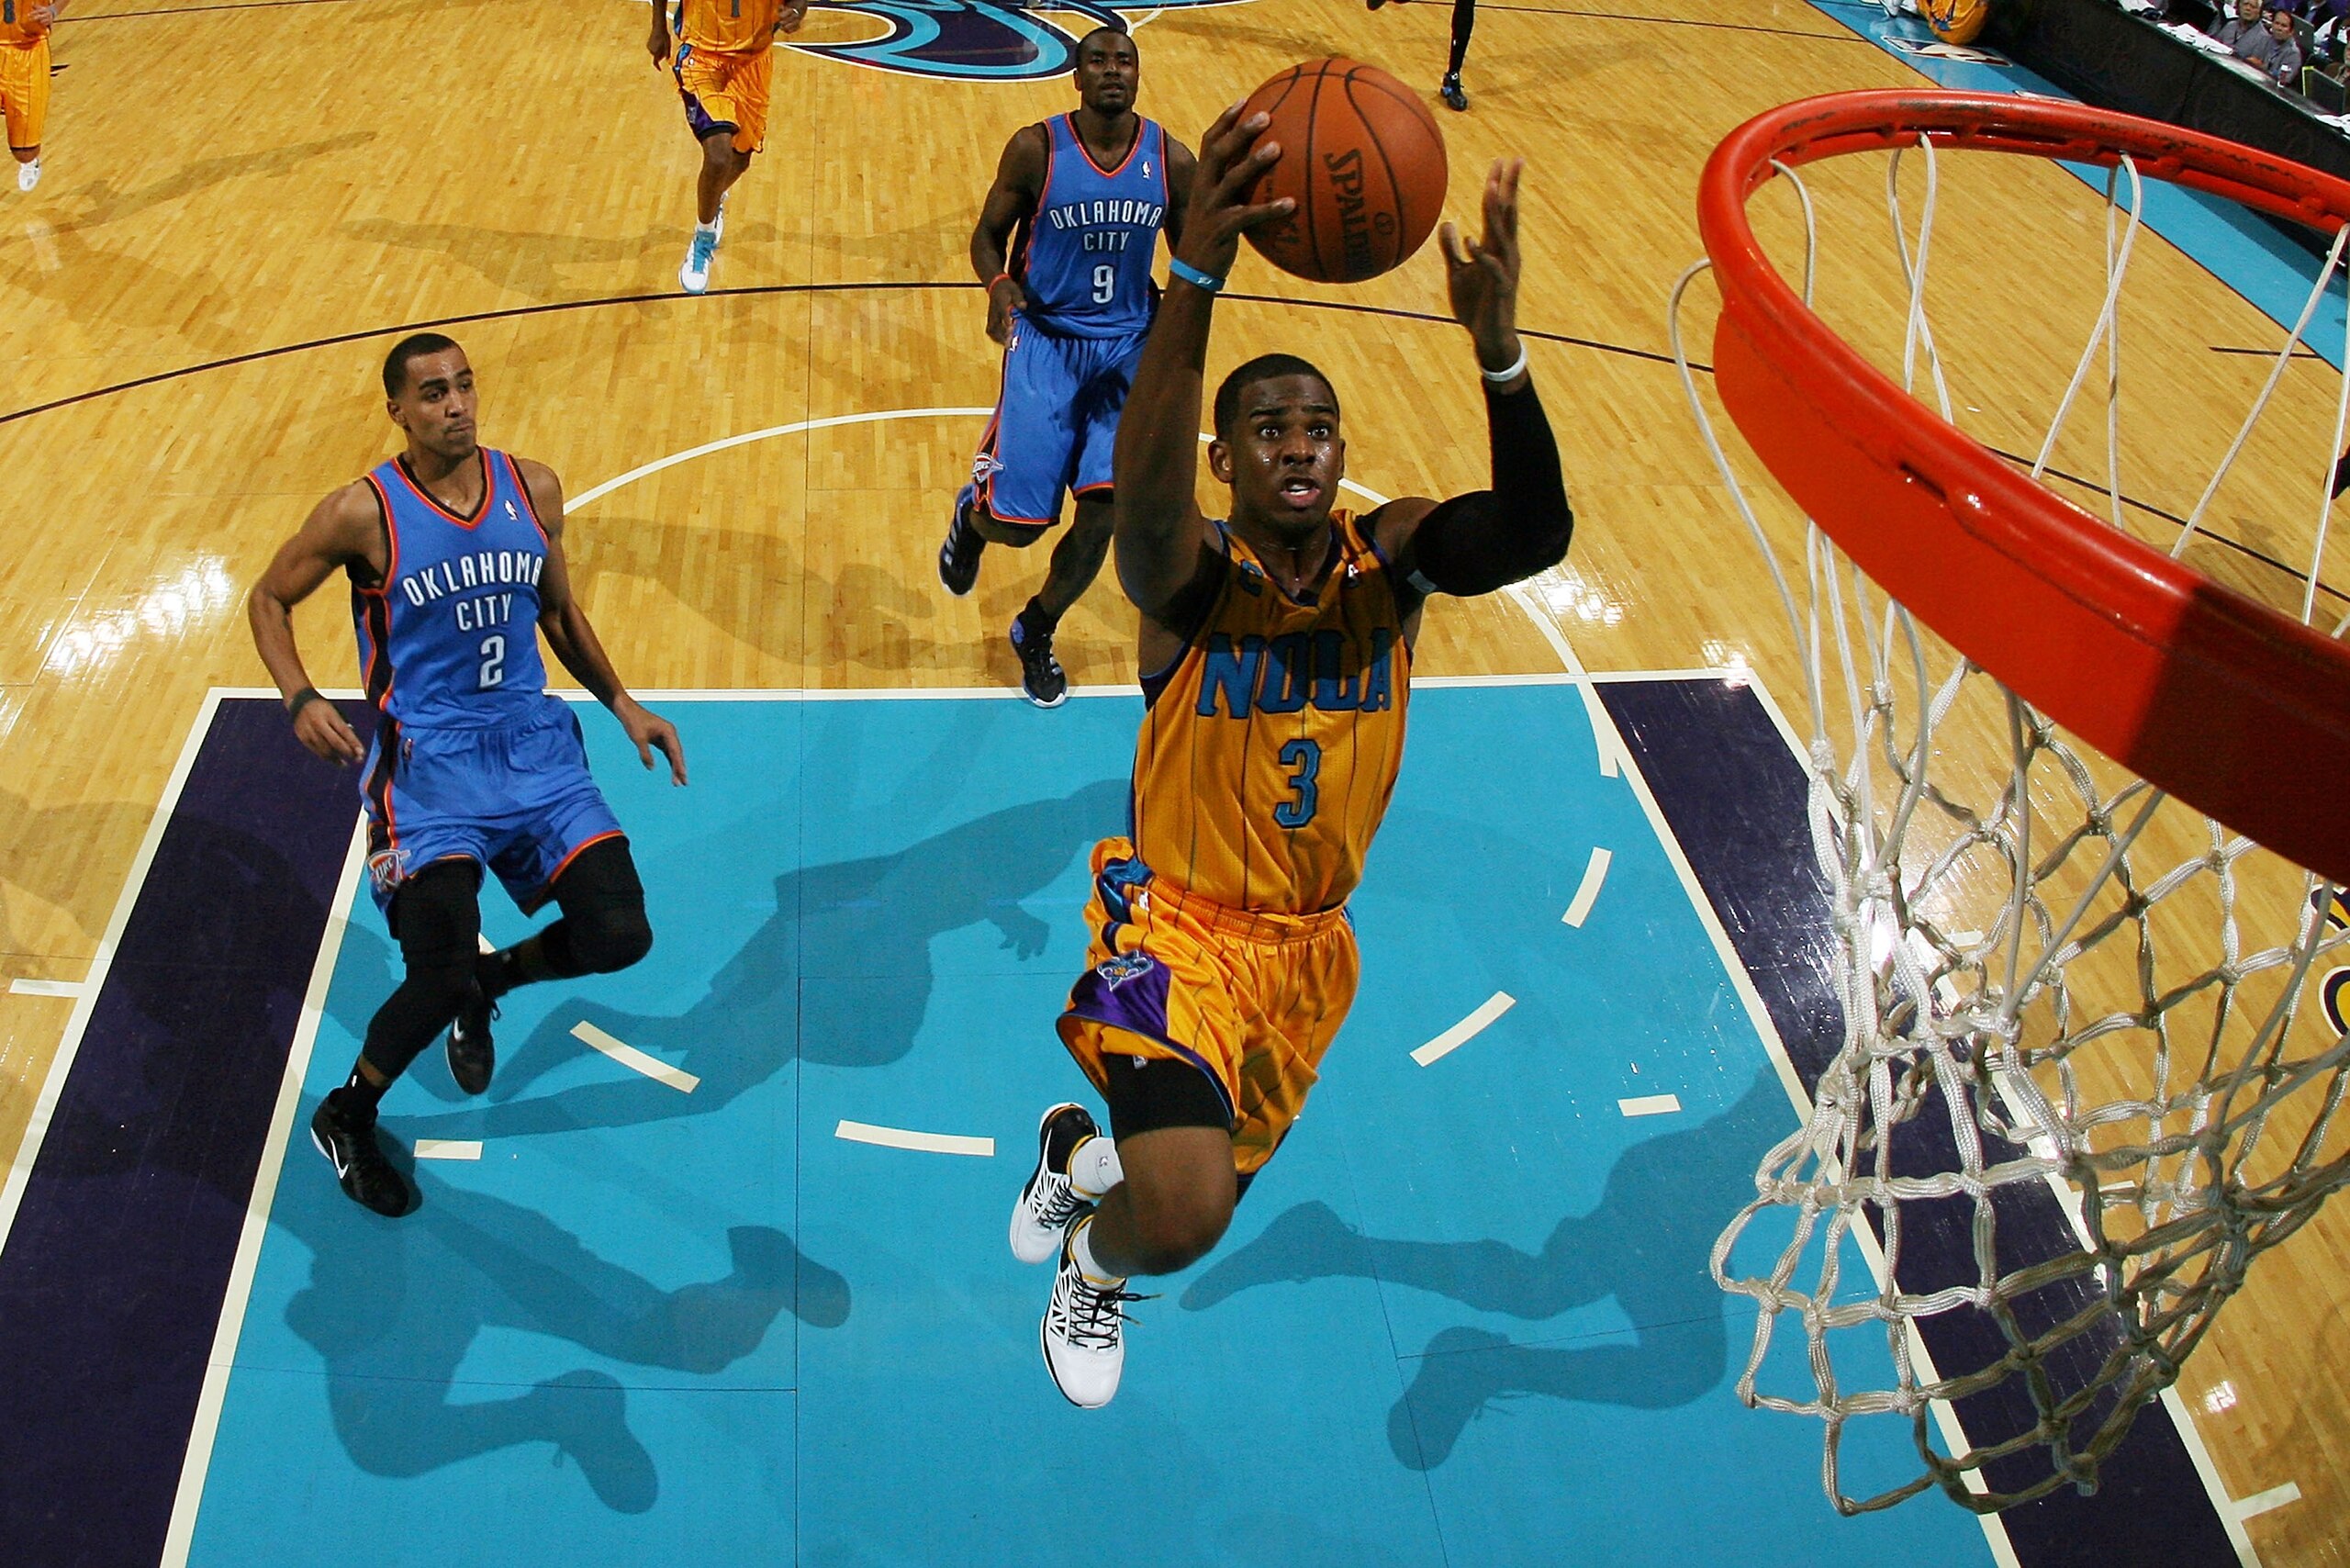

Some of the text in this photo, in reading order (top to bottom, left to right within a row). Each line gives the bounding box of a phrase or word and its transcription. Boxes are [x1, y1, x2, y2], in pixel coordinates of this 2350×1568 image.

[1049, 200, 1162, 230] OKLAHOMA
[1083, 231, 1130, 251] CITY
[1092, 264, 1114, 304] 9
[402, 551, 543, 608] OKLAHOMA
[456, 593, 511, 632] CITY
[479, 635, 504, 689] 2
[1196, 627, 1392, 720] NOLA
[1273, 738, 1321, 829] 3
